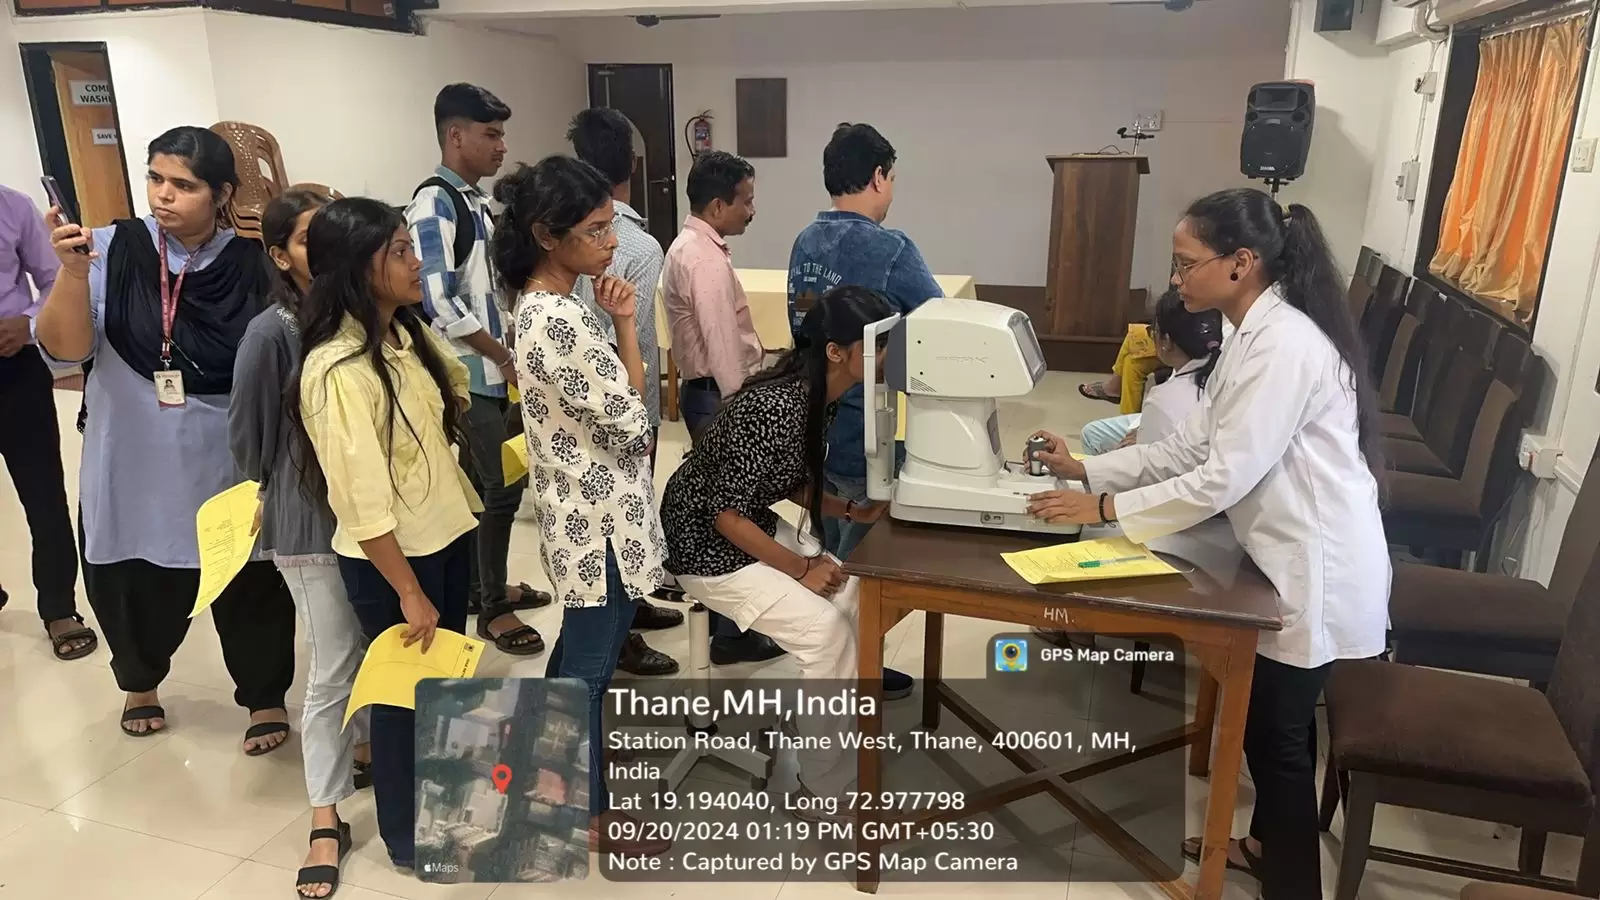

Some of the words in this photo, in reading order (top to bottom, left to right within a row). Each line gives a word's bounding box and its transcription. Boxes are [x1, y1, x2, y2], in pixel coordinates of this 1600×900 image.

[803, 262, 810, 273] TO
[812, 263, 822, 275] THE
[823, 268, 842, 285] LAND
